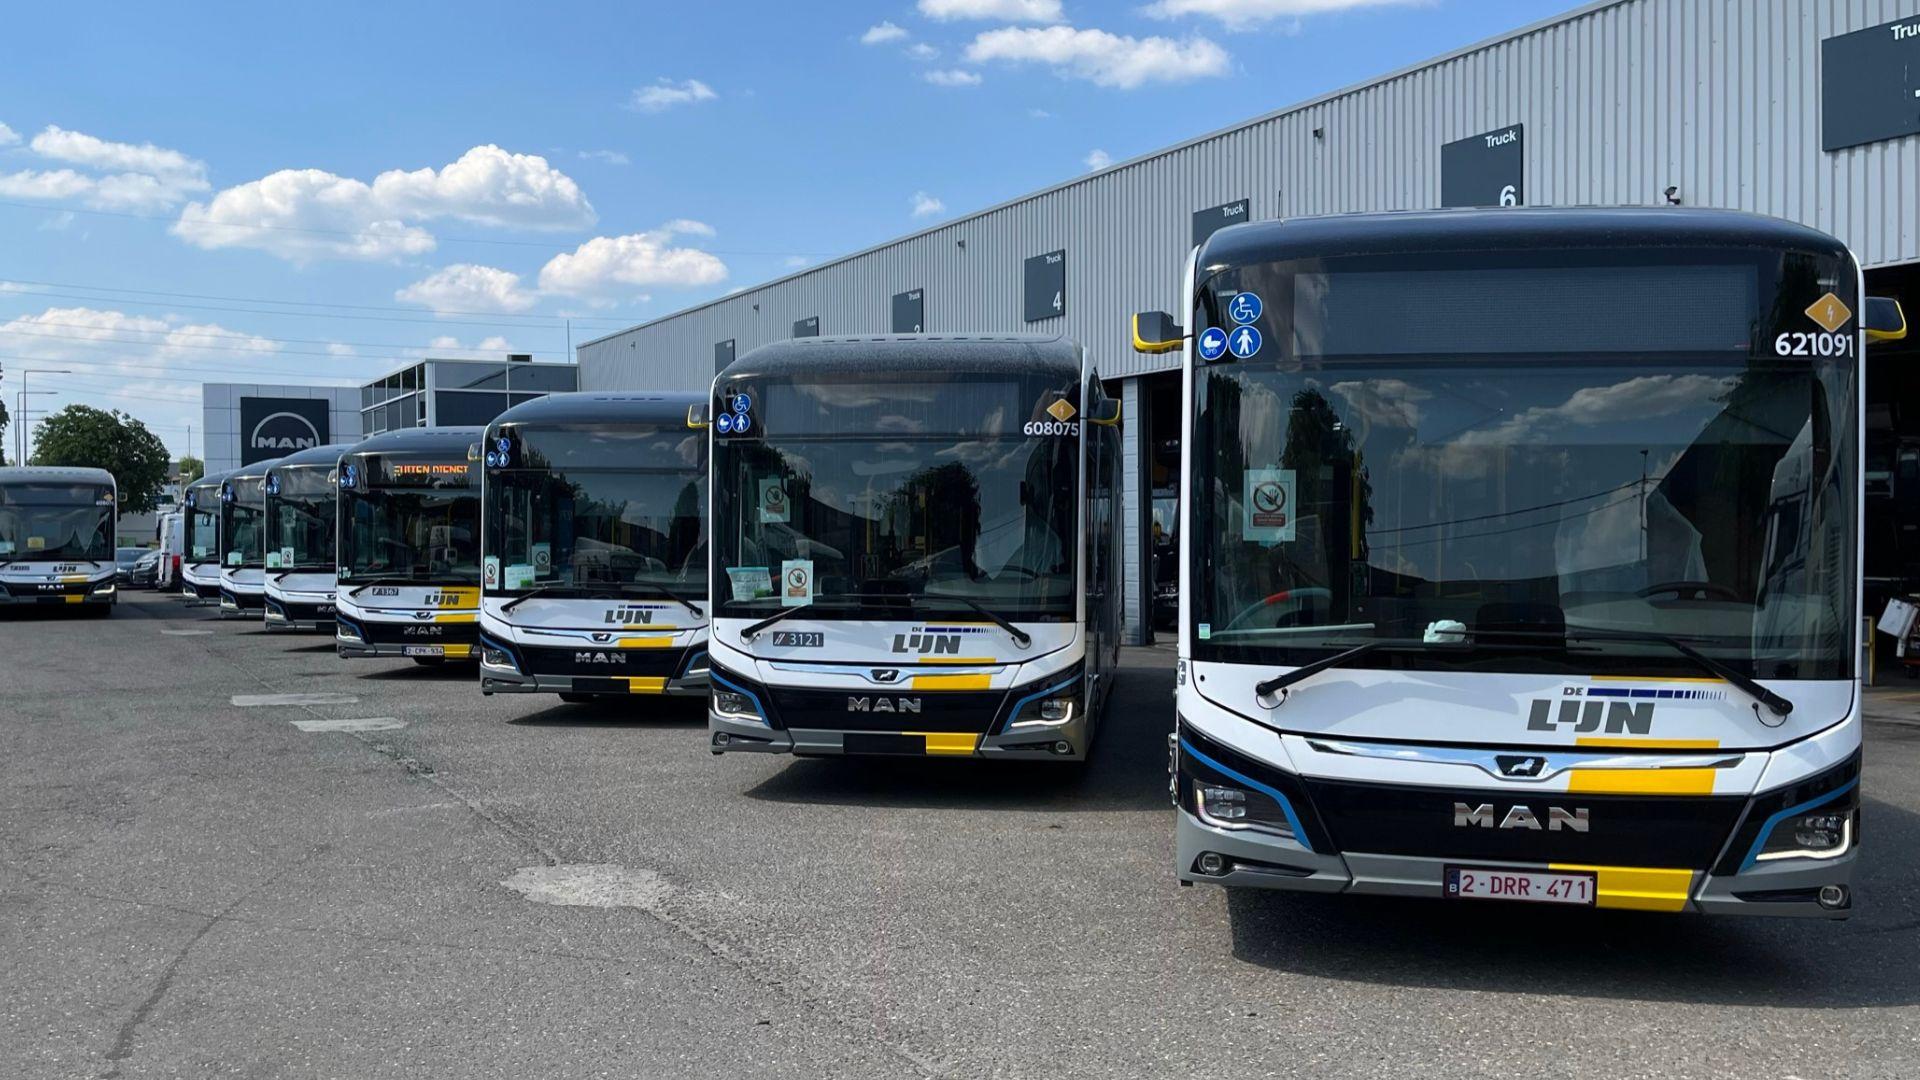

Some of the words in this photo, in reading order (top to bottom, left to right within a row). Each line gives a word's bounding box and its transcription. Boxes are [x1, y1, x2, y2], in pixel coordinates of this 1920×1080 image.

[1890, 24, 1920, 40] Tru
[1485, 130, 1516, 148] Truck
[1500, 185, 1516, 206] 6
[1222, 203, 1244, 217] Truck
[1046, 253, 1061, 264] Truck
[1053, 291, 1062, 311] 4
[1775, 332, 1853, 358] 621091
[1023, 421, 1079, 436] 608075
[257, 436, 315, 449] MAN
[424, 595, 460, 605] LIJN
[604, 610, 653, 624] LIJN
[403, 626, 442, 635] MAN
[789, 634, 820, 646] 3121
[892, 634, 962, 654] LIJN
[575, 652, 626, 663] MAN
[1563, 687, 1583, 696] DE
[848, 697, 922, 713] MAN
[1526, 699, 1656, 735] LIJN
[1454, 802, 1590, 833] MAN
[1449, 883, 1458, 893] B
